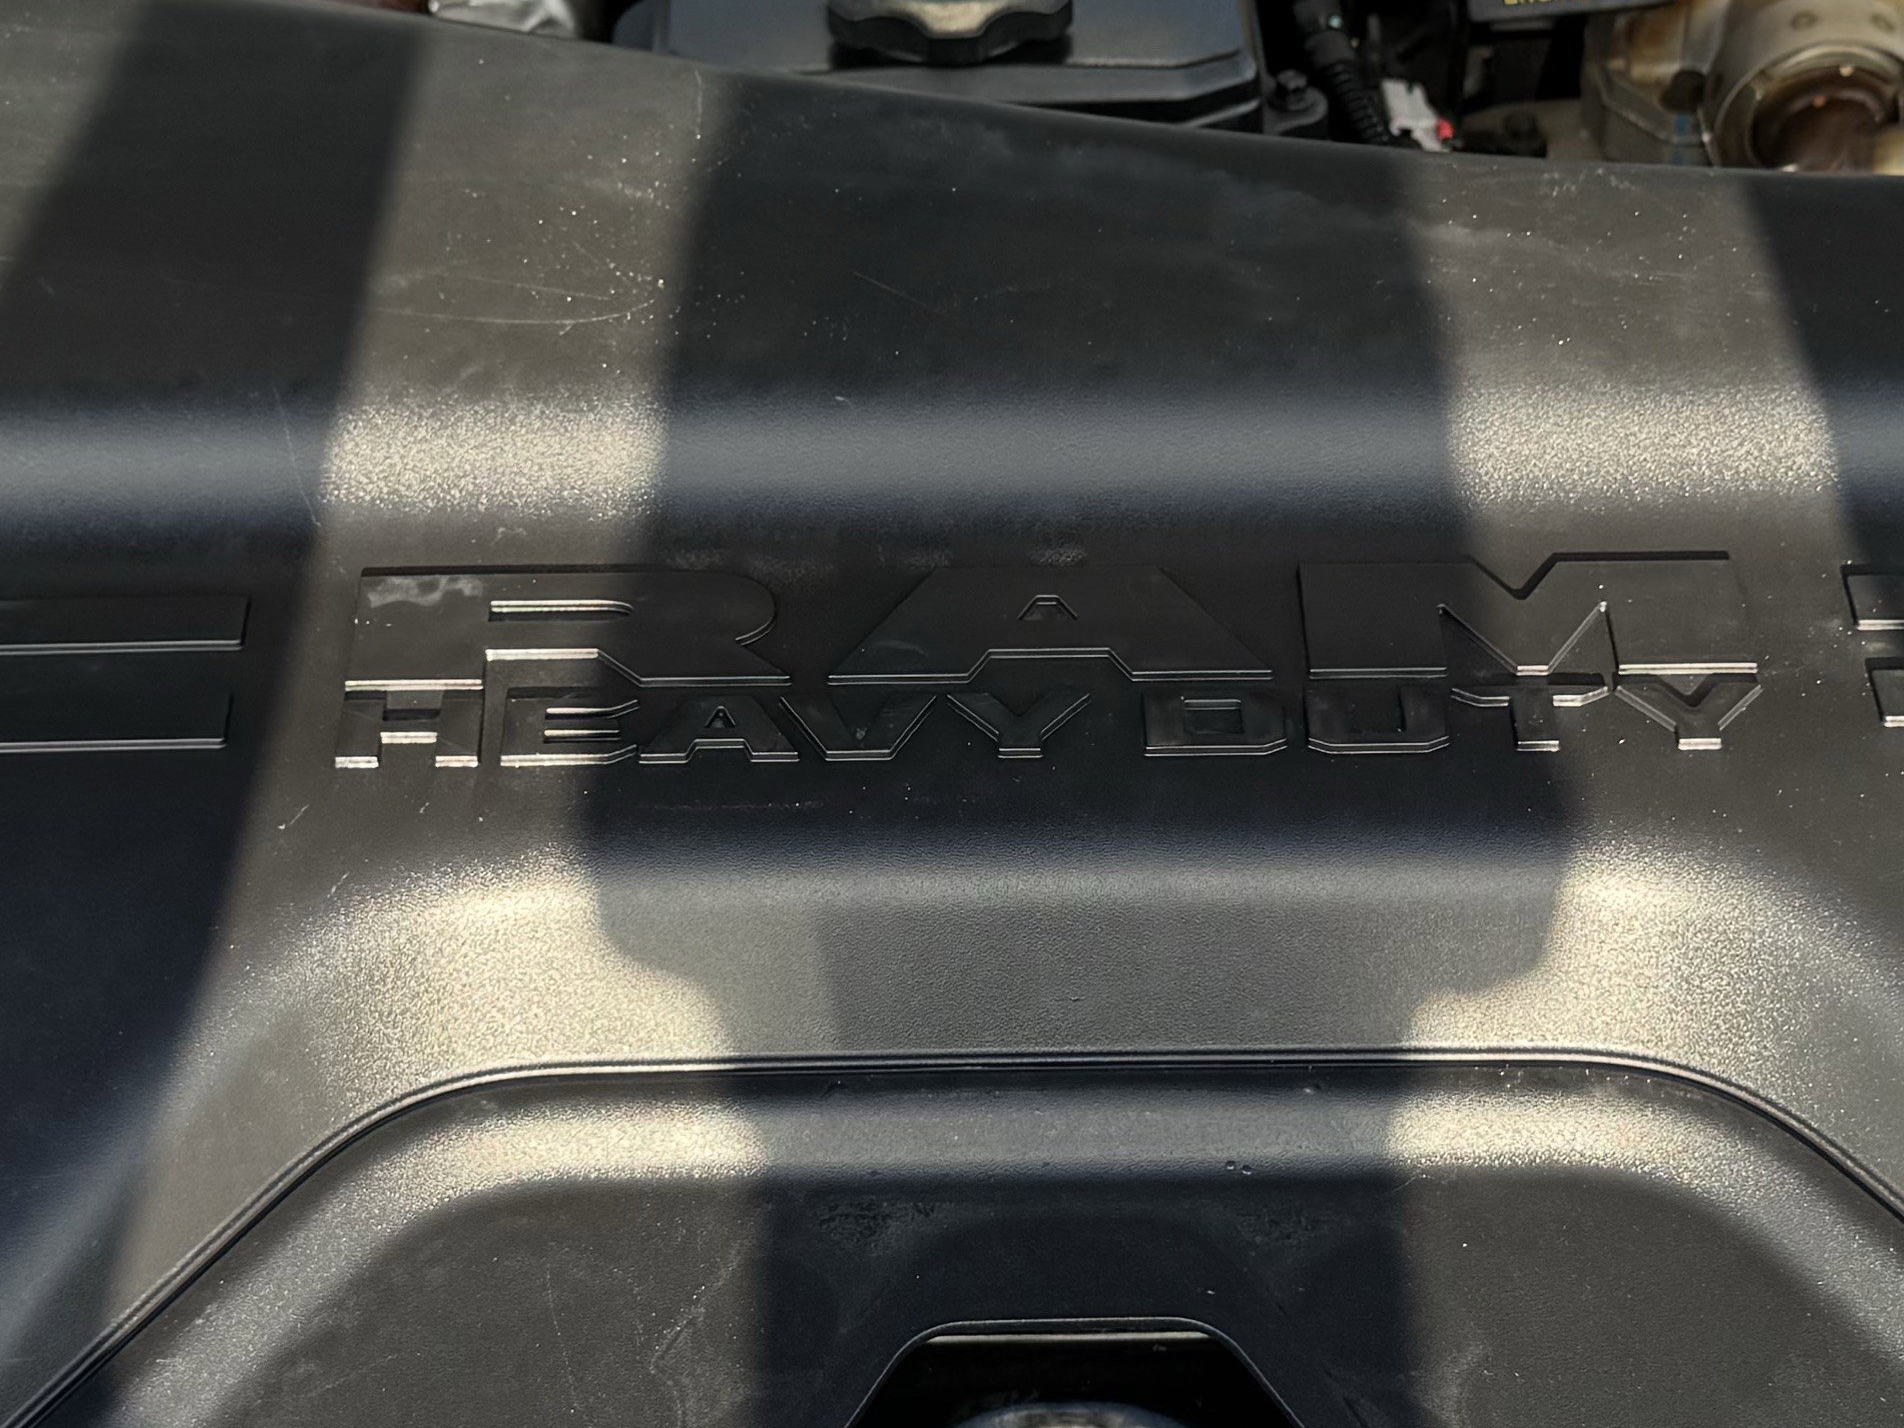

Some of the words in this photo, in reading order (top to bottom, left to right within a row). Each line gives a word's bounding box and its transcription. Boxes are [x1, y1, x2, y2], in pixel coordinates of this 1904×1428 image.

[343, 551, 1759, 690] RAM
[334, 684, 1093, 769] HEAVY
[1143, 673, 1763, 758] DUTY
